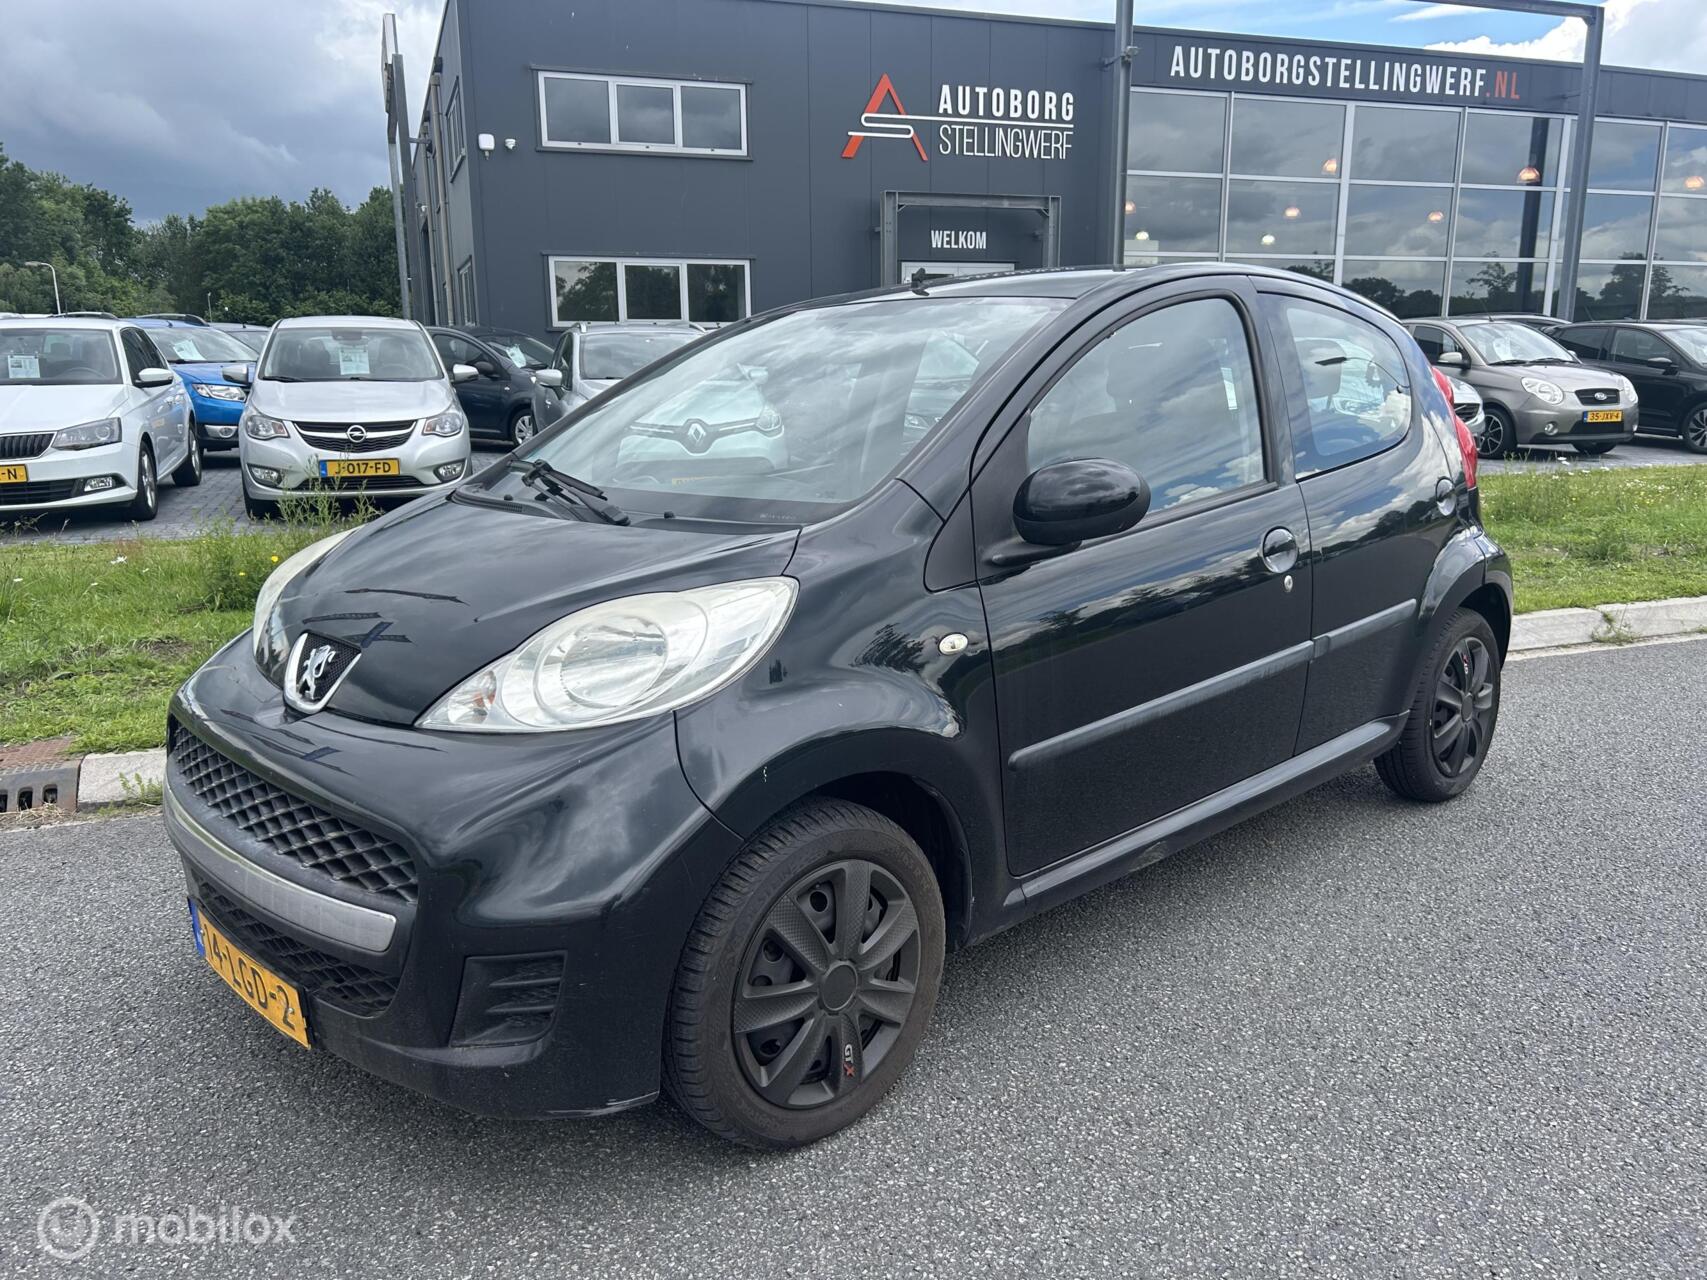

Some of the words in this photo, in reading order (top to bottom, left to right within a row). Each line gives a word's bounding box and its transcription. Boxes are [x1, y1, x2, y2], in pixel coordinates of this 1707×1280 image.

[1169, 45, 1521, 101] AUTOBORGSTELLINGWERF.NL
[938, 84, 1075, 122] AUTOBORG
[939, 124, 1075, 160] STELLINGWERF
[931, 230, 987, 249] WELKOM
[335, 461, 391, 475] J-017-FD
[203, 923, 296, 1031] 14-LGD-2
[843, 1043, 857, 1078] GTX
